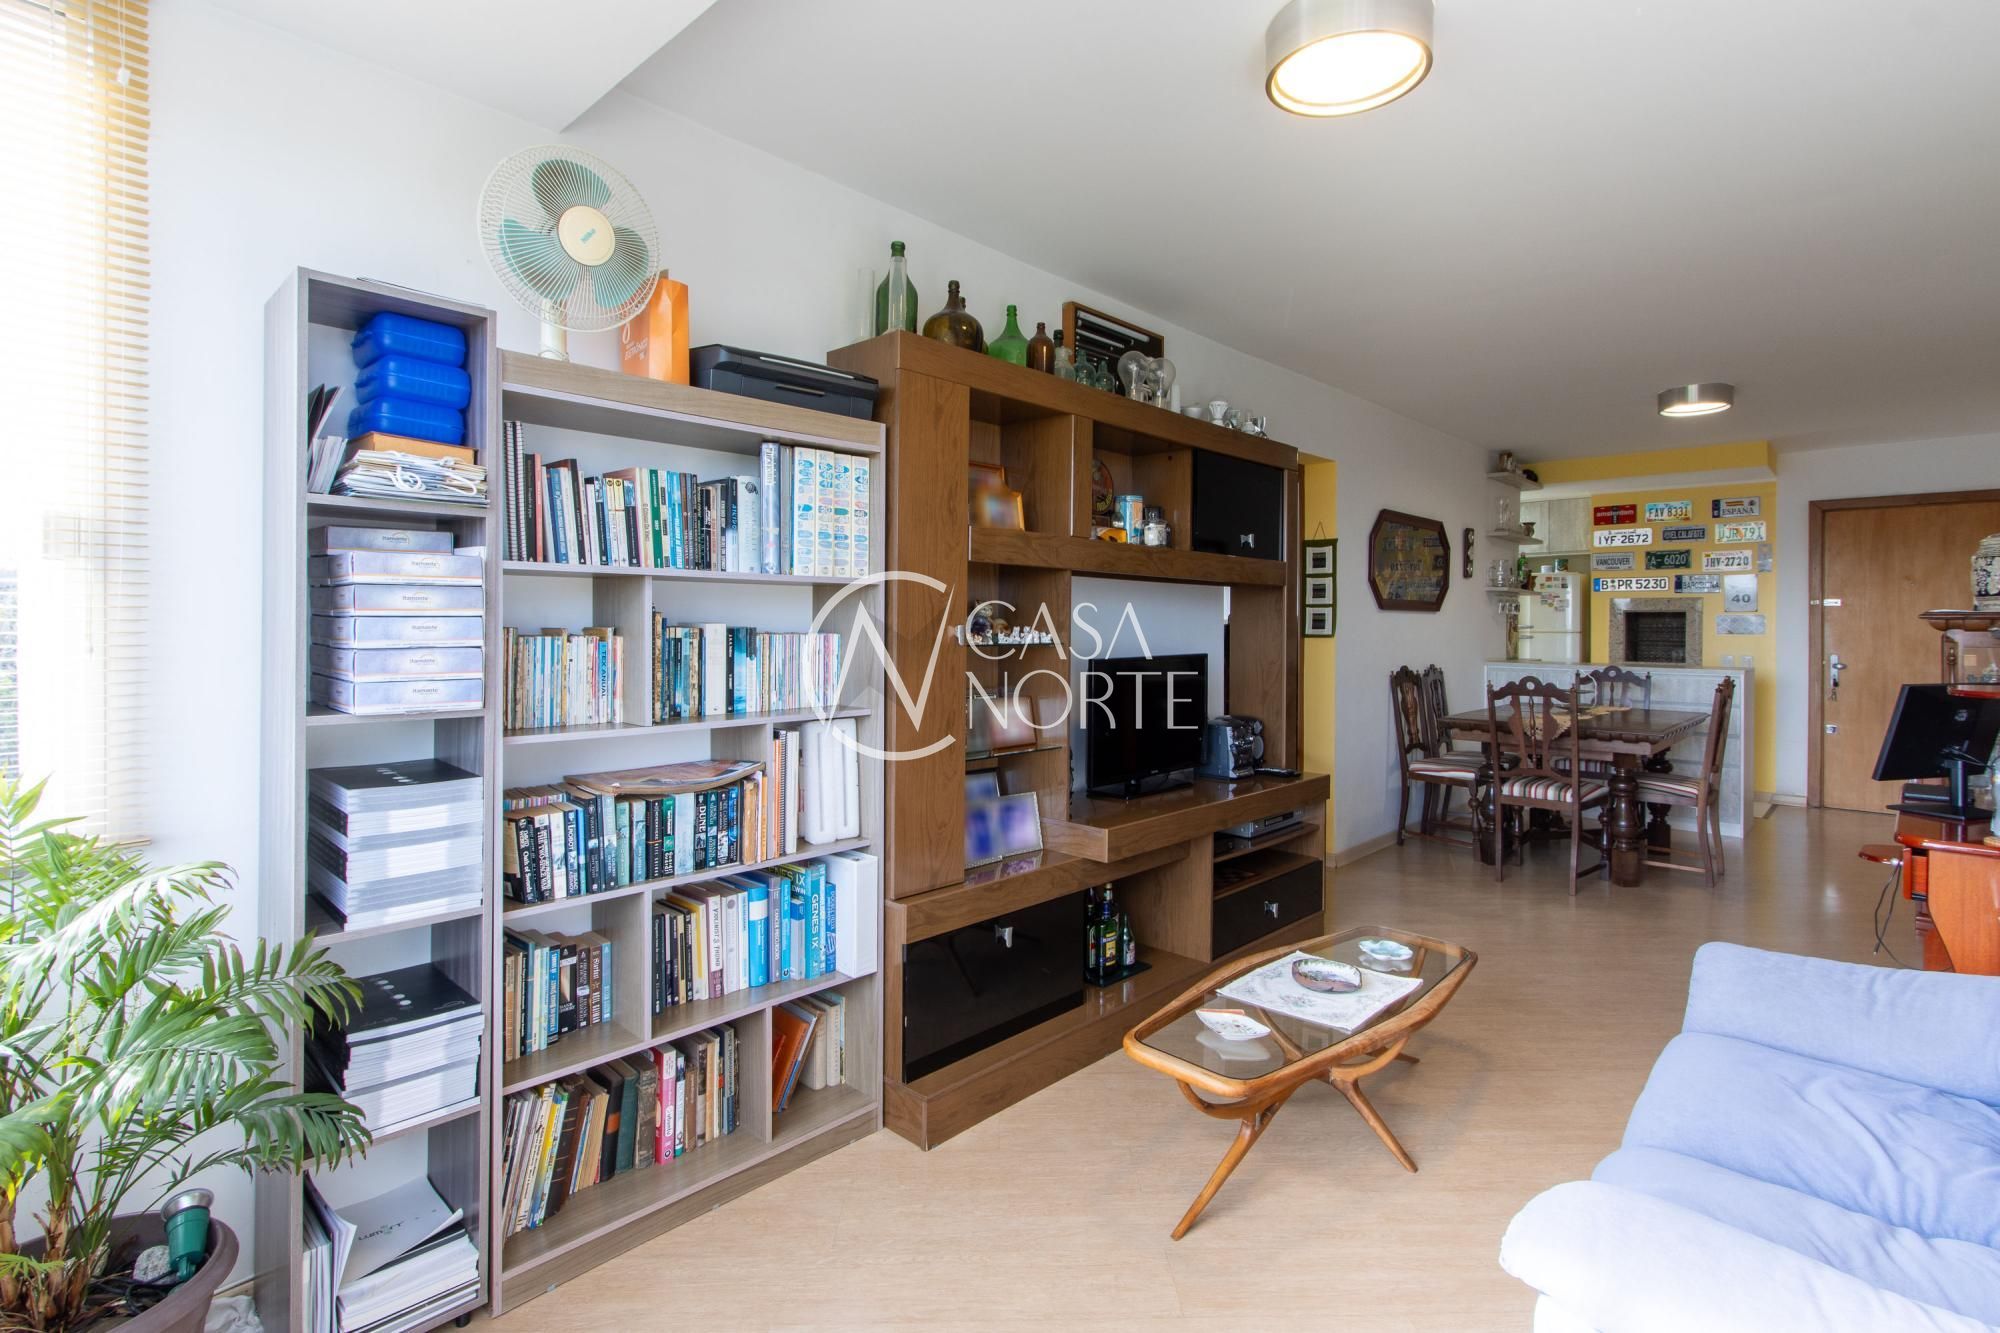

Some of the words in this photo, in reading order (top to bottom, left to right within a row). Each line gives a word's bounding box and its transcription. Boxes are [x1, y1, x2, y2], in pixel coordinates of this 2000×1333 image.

[1595, 557, 1631, 567] VANCOUVER
[1617, 579, 1633, 590] PR
[1635, 578, 1667, 590] 5230
[1731, 593, 1752, 604] 40
[698, 805, 707, 833] DUNE
[811, 893, 819, 934] GENES
[811, 936, 819, 949] IX
